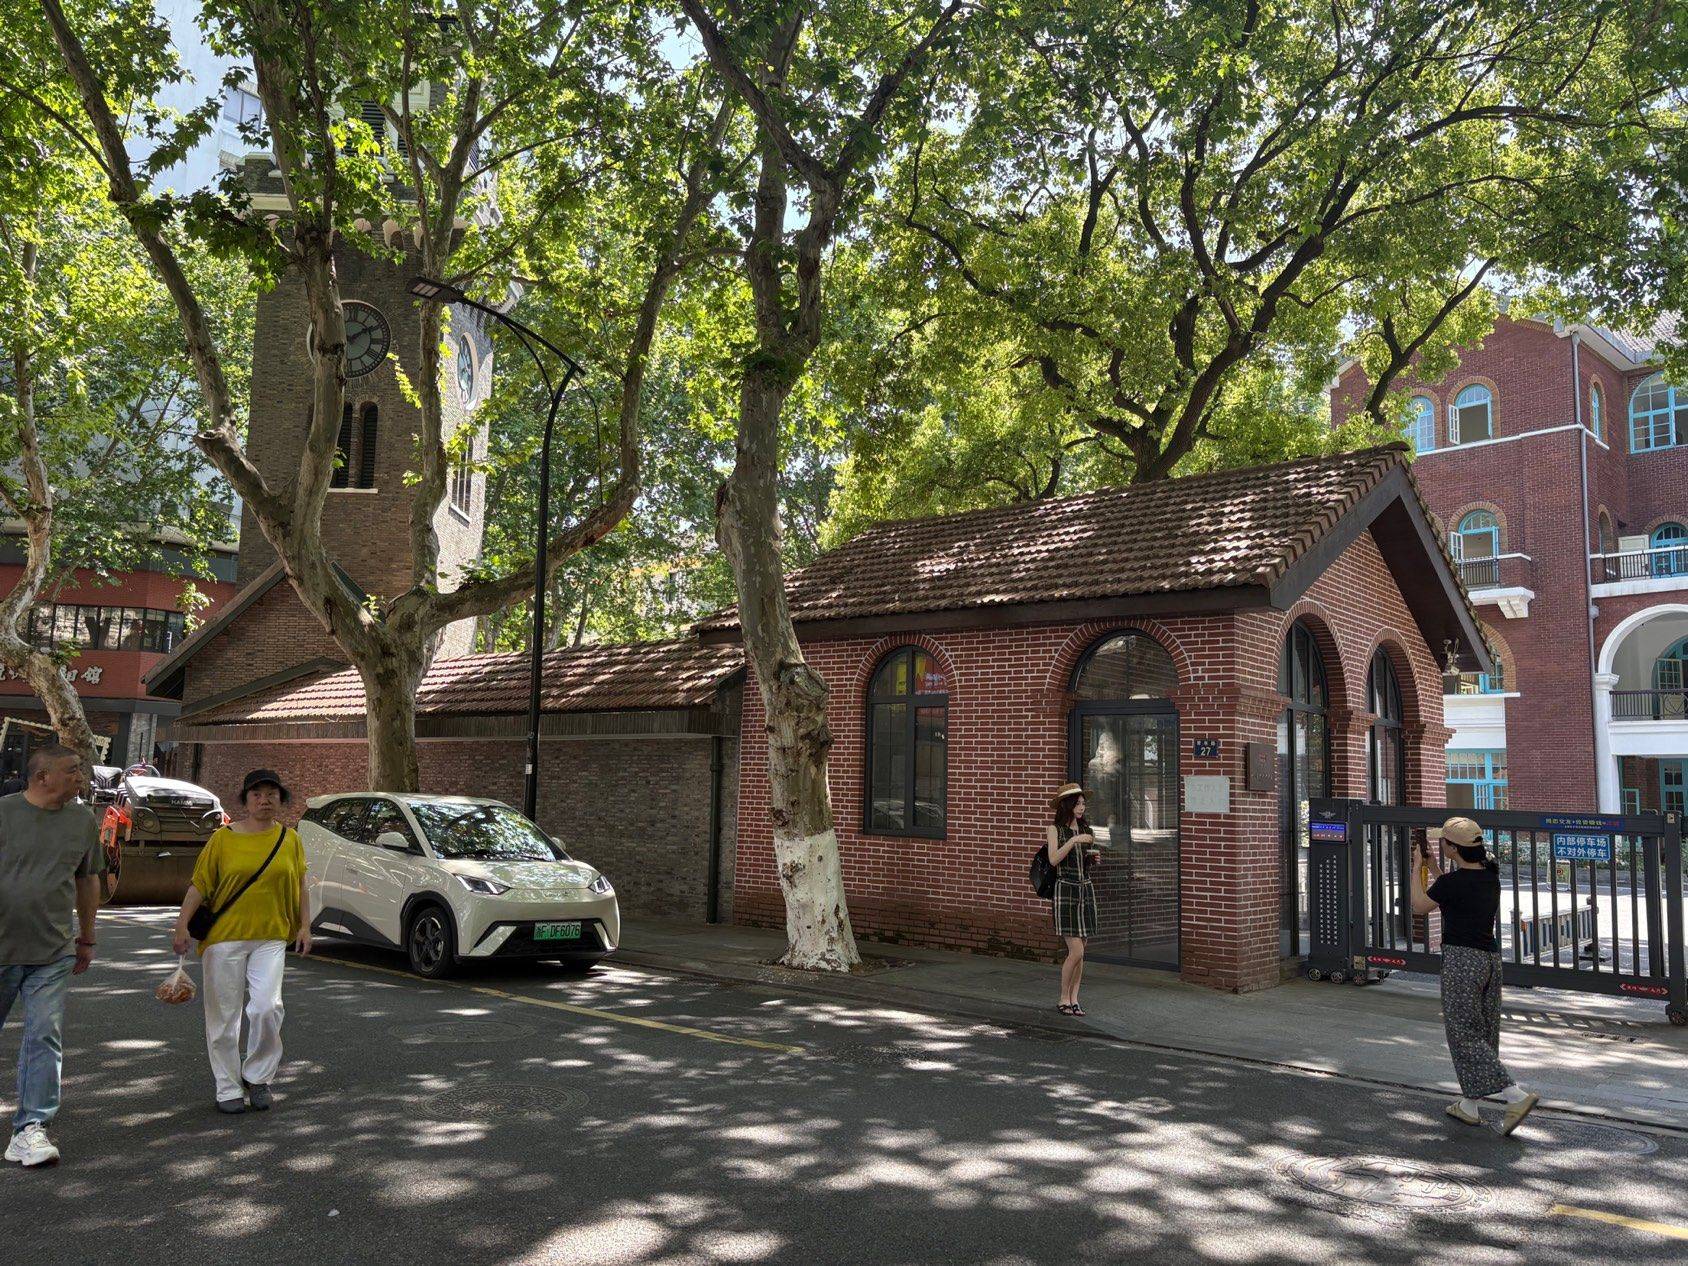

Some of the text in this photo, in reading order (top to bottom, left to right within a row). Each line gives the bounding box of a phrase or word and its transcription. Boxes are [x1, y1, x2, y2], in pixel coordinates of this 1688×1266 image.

[1200, 746, 1211, 756] 27
[1556, 836, 1607, 847] 内部停车场
[1557, 846, 1607, 858] 不对外停车
